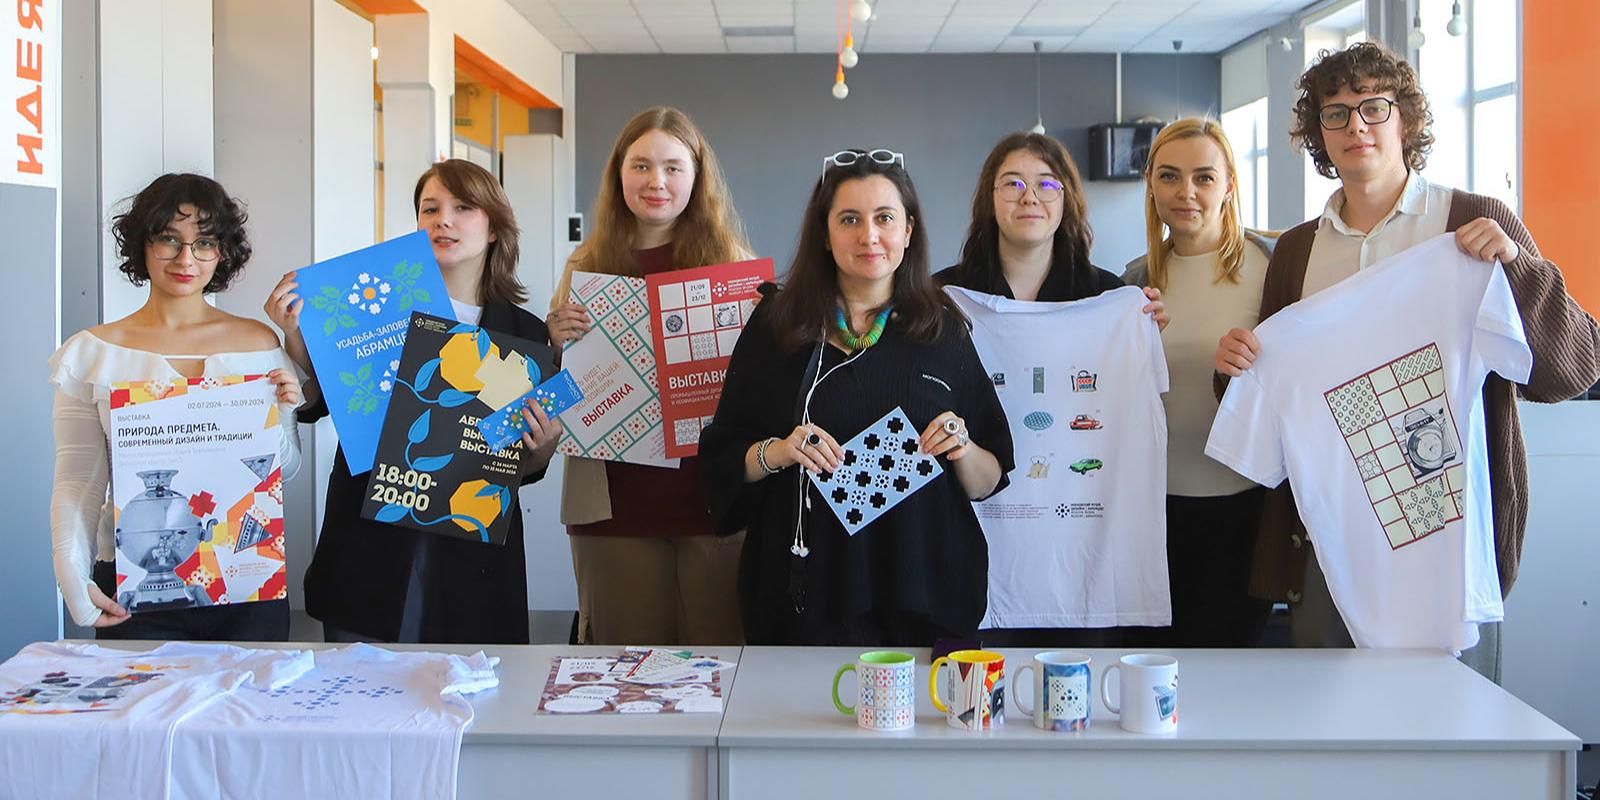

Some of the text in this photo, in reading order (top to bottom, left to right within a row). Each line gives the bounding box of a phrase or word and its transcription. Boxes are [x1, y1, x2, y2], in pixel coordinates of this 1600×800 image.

[16, 0, 43, 175] ИДЕЯ
[335, 315, 413, 350] УСАДЬБА-ЗАПОВЕ
[668, 369, 728, 390] ВЫСТАВК
[187, 401, 222, 409] 02.07.2024
[230, 398, 265, 407] 30.09.2024
[581, 382, 634, 428] ВЫСТАВКА
[117, 414, 151, 422] ВЫСТАВКА
[118, 422, 220, 438] ПРИРОДА ПРЕДМЕТА.
[118, 437, 173, 448] СОВРЕМЕННЫЙ
[175, 435, 206, 446] ДИЗАЙН
[215, 432, 253, 442] ТРАДИЦИИ
[376, 463, 438, 490] 18:00-
[370, 483, 430, 512] 20:00
